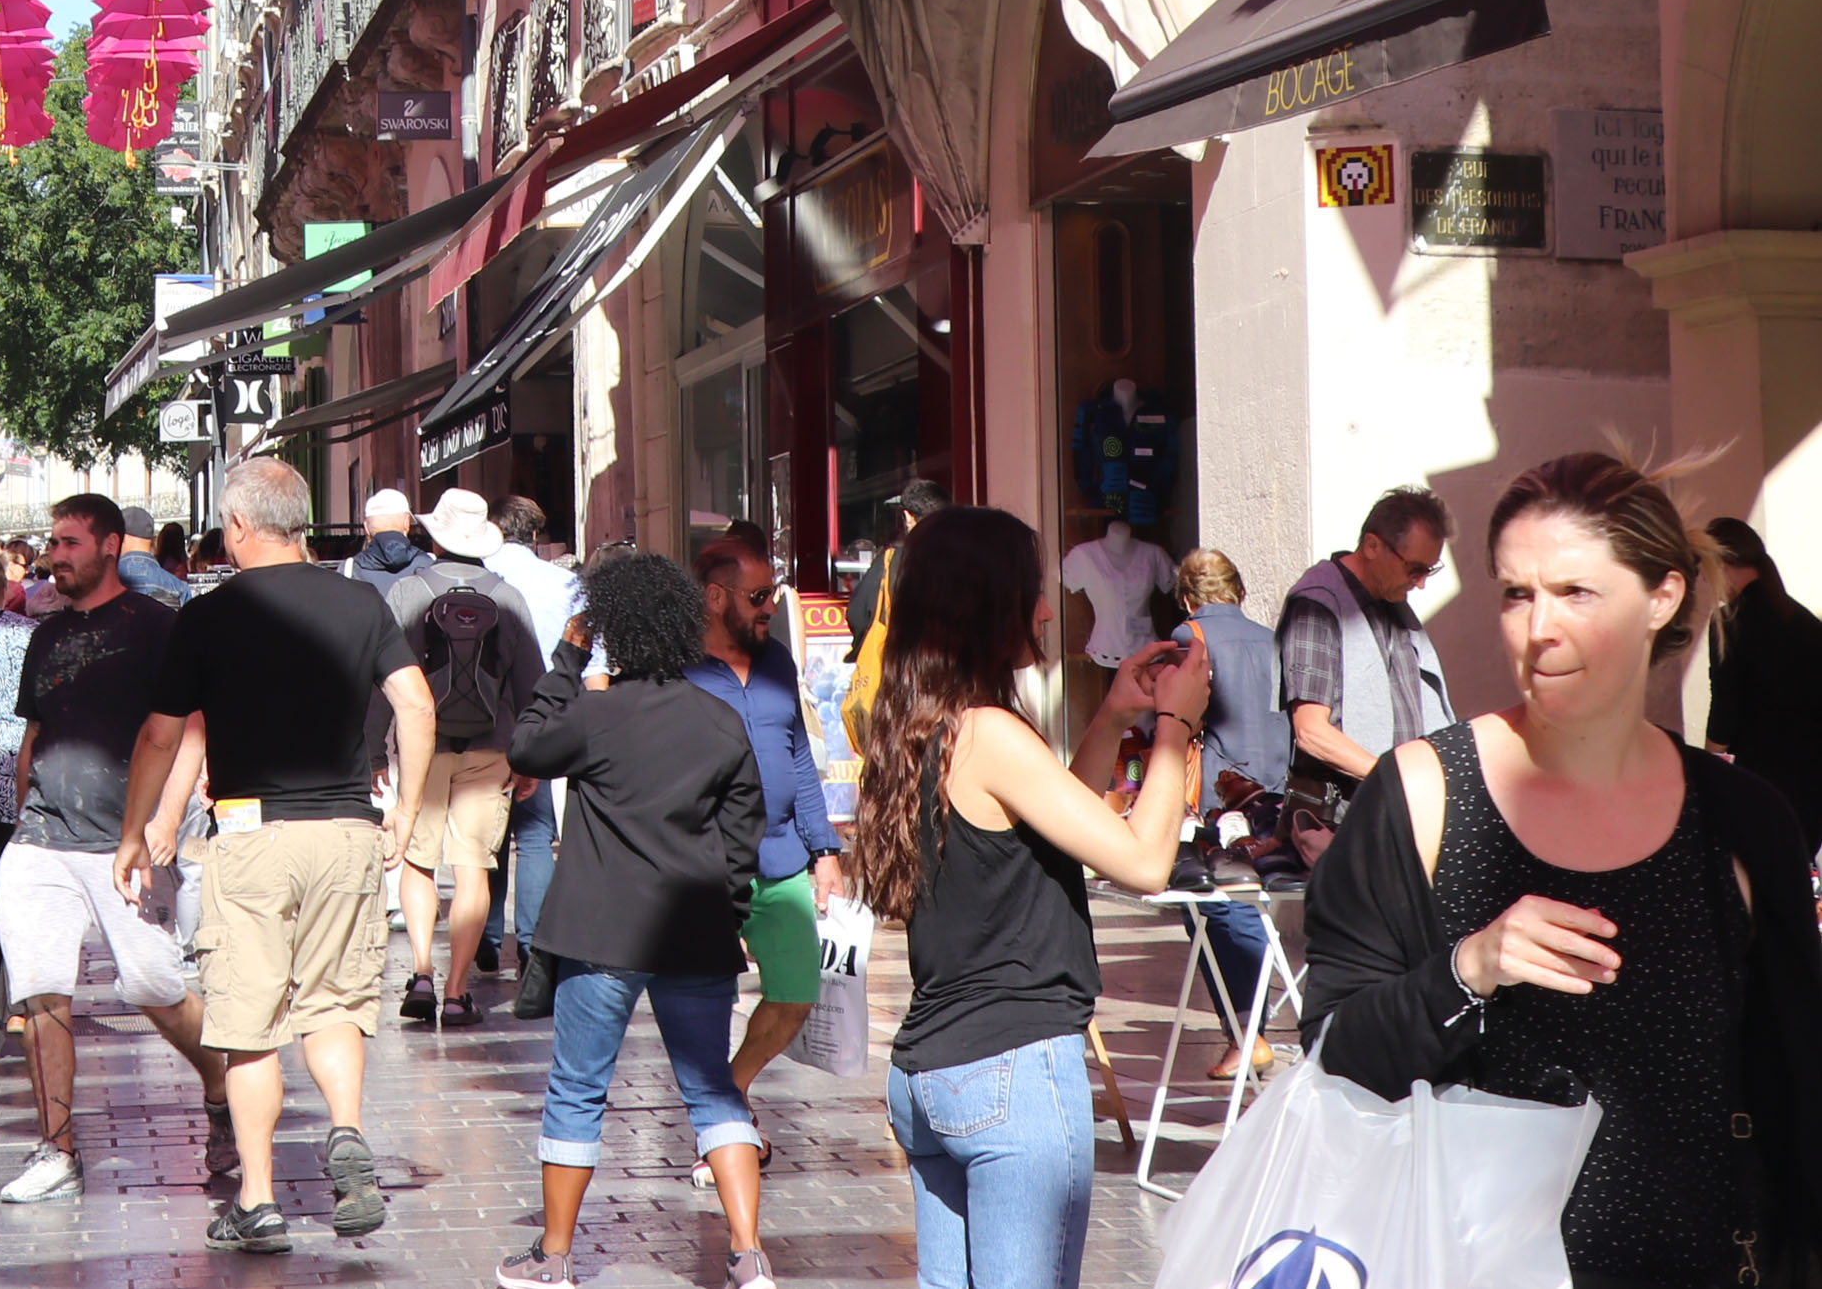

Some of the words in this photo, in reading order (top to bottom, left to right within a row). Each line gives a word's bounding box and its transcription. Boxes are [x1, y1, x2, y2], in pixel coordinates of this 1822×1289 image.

[1265, 42, 1355, 116] BOCAGE
[380, 118, 449, 130] SWAROVSKI
[1632, 144, 1650, 166] le
[1414, 188, 1444, 205] DES
[1436, 216, 1455, 235] DE
[228, 363, 292, 372] ELECTRONIQUE
[167, 413, 191, 428] loge
